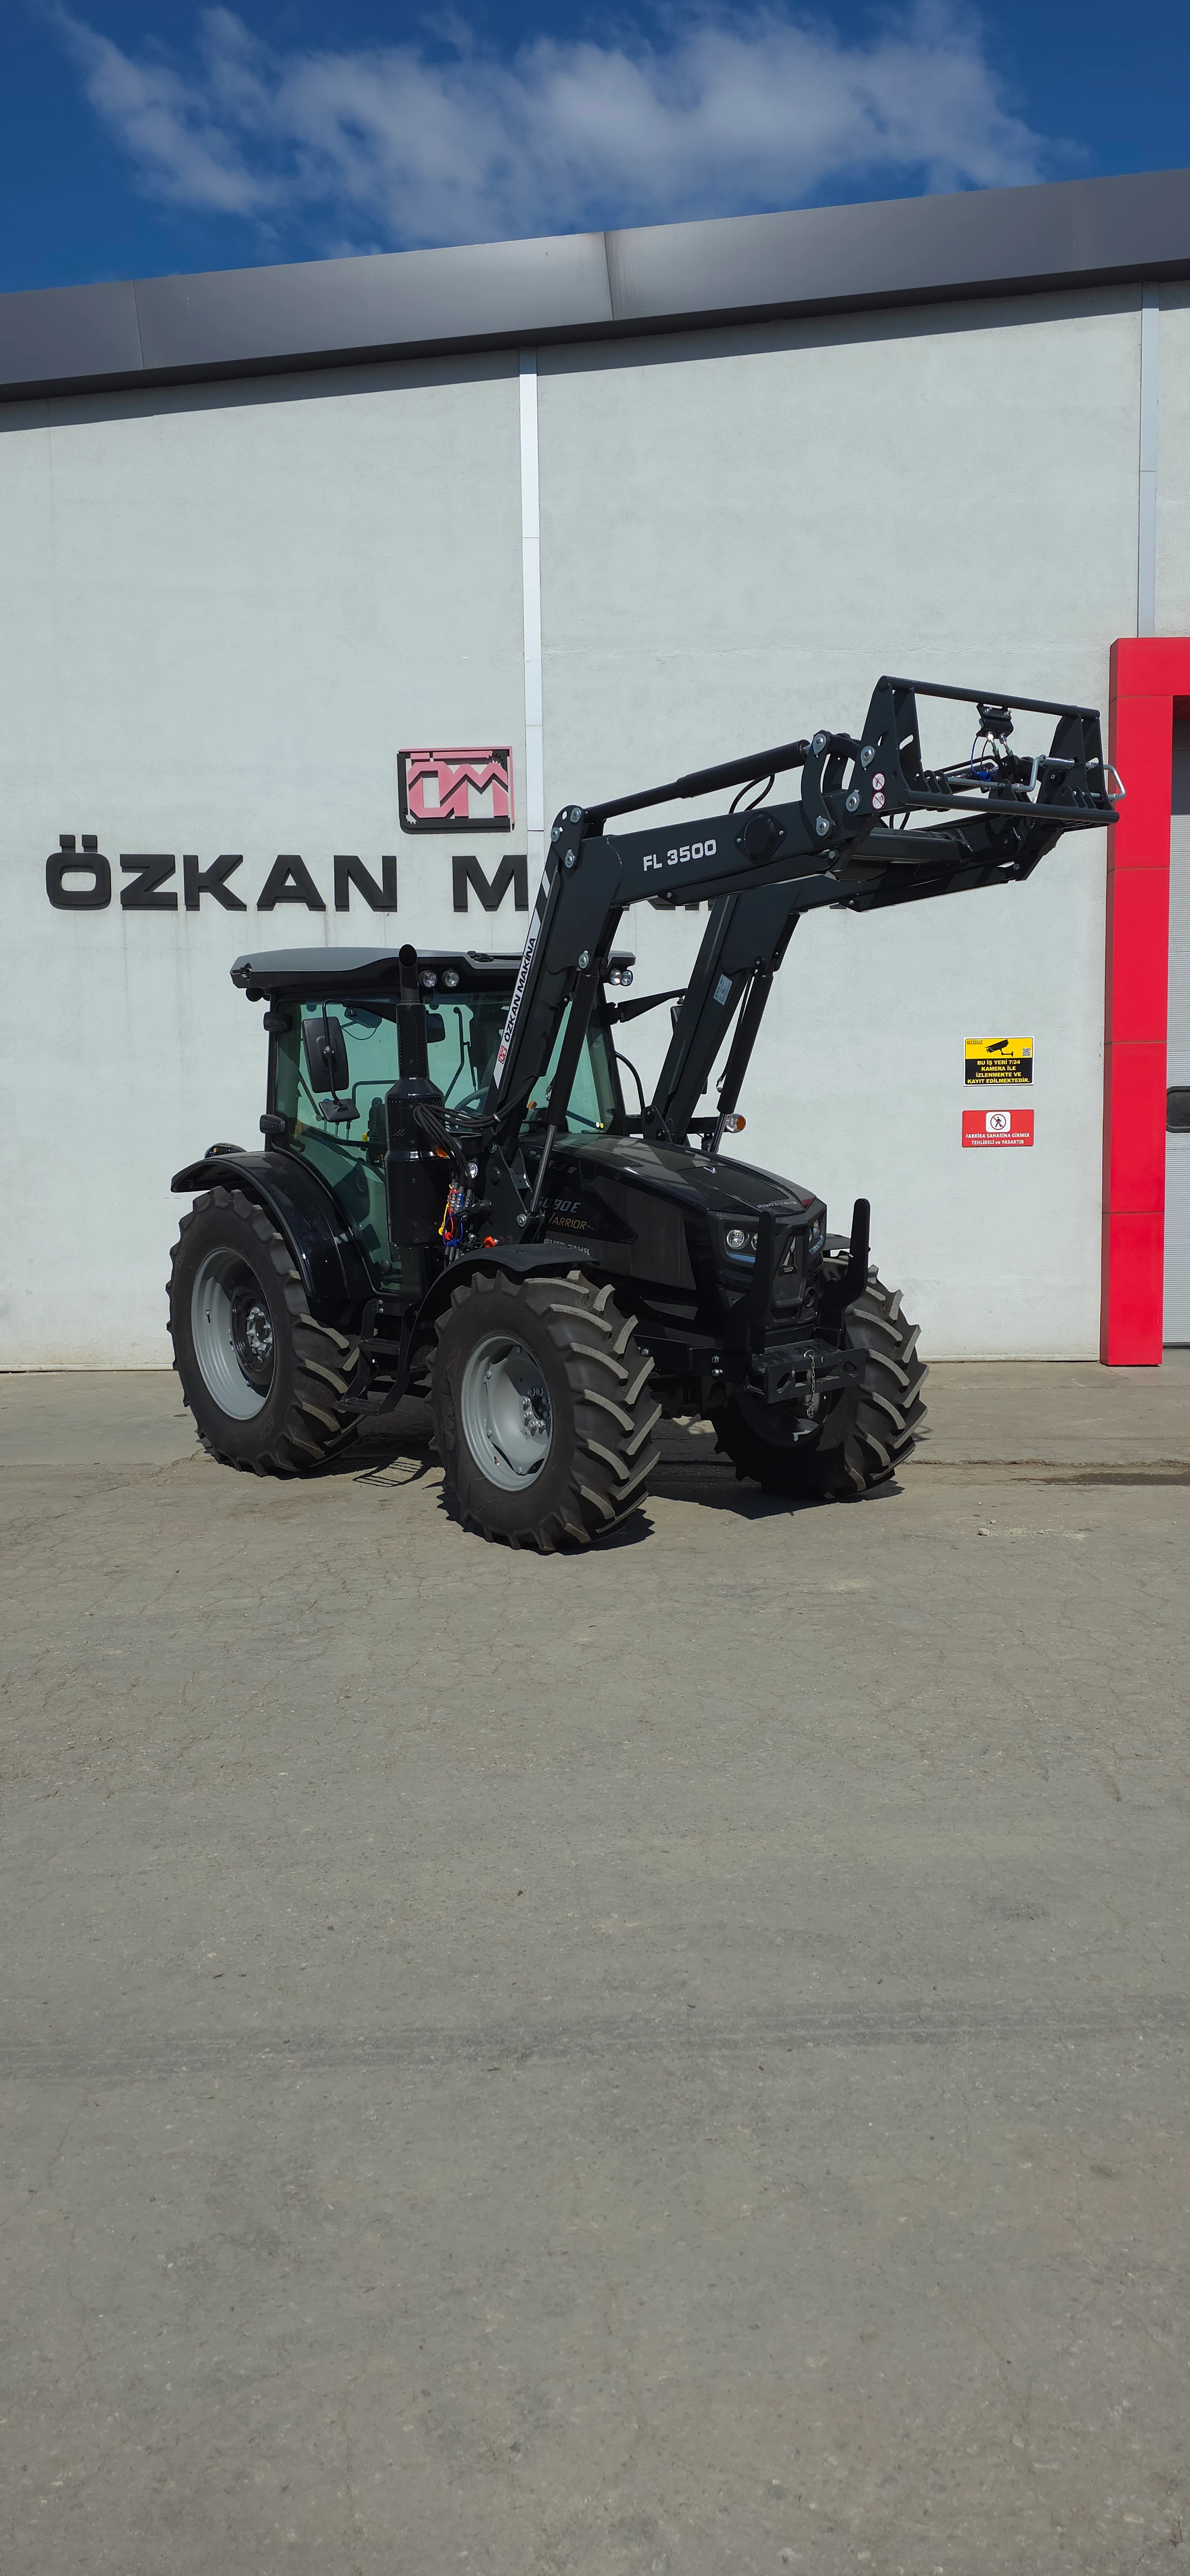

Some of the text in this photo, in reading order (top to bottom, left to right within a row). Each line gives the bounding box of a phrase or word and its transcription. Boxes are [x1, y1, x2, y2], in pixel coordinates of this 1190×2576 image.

[46, 834, 398, 912] ÖZKAN
[643, 839, 716, 871] FL 3500
[504, 994, 521, 1043] ÖZKAN
[517, 938, 536, 993] MAKİNA
[548, 1212, 587, 1230] ARRIOR
